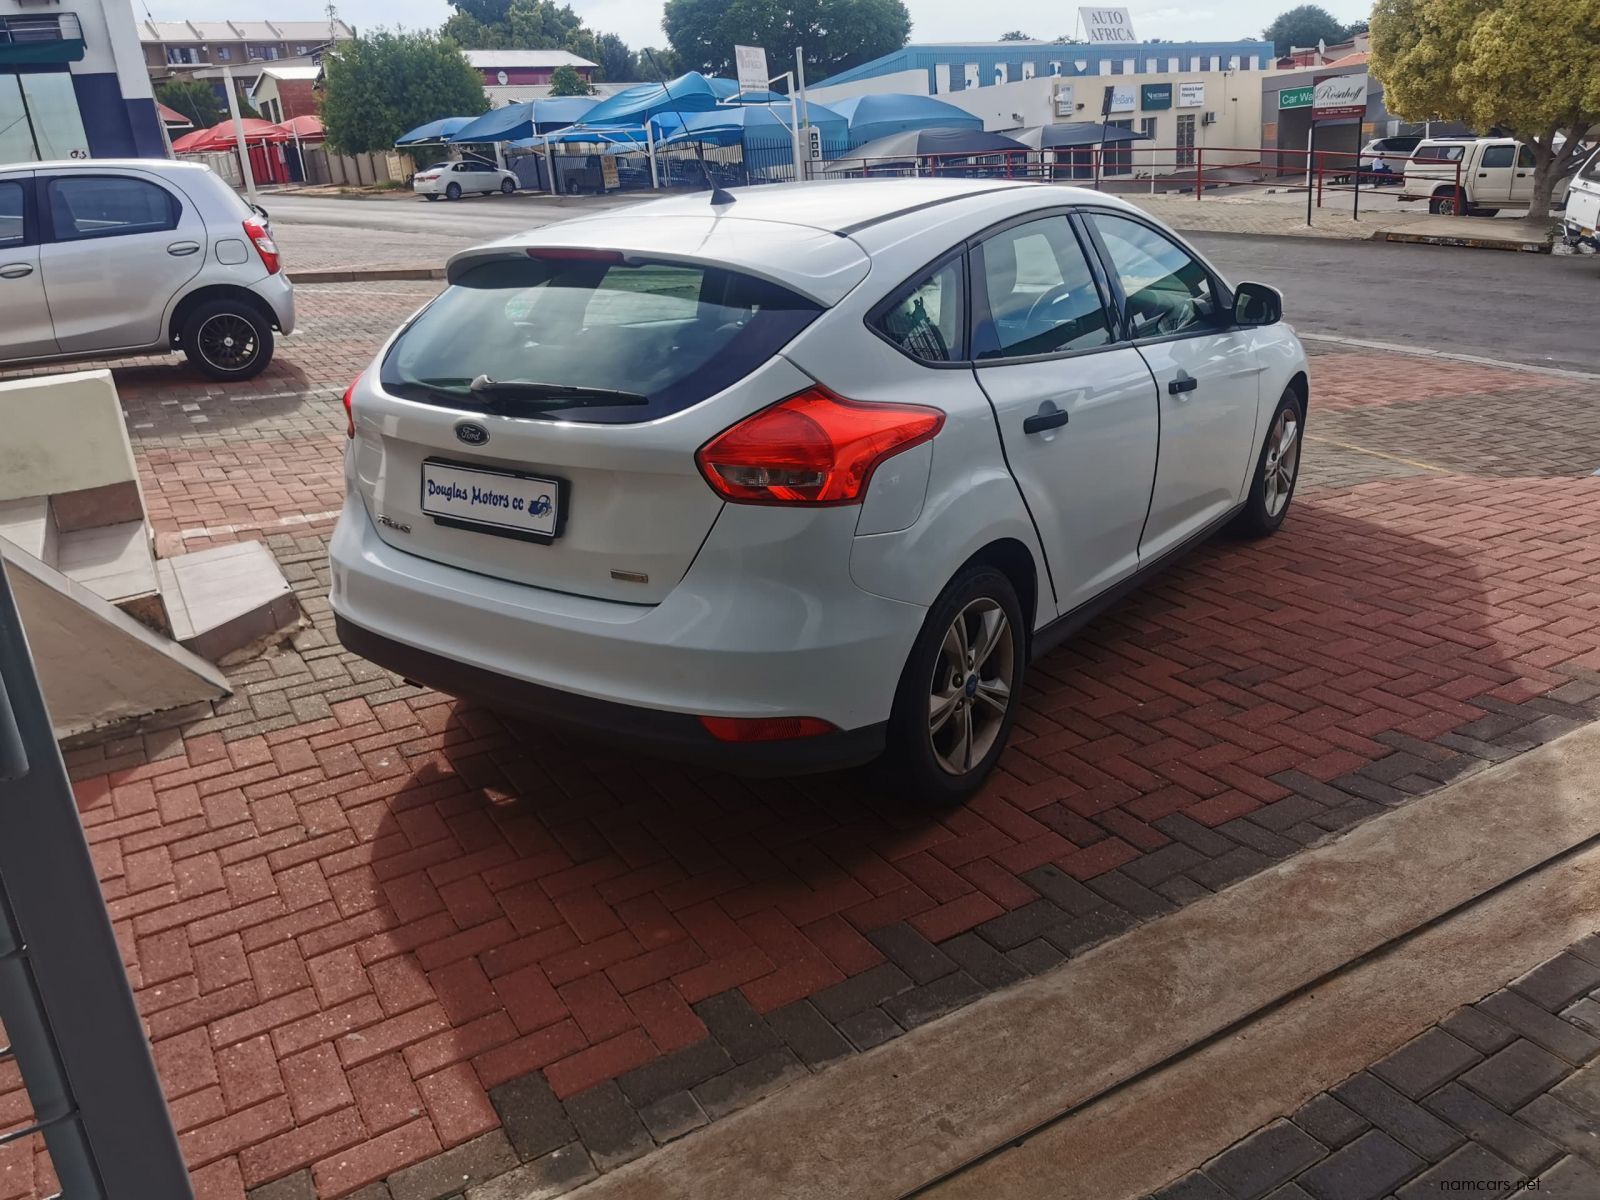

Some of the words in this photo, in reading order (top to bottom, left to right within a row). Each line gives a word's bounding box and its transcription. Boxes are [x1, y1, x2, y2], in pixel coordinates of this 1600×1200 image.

[1091, 11, 1123, 24] AUTO
[1091, 27, 1135, 41] AFRICA
[1282, 94, 1298, 105] Car
[462, 426, 480, 441] Ford
[427, 479, 468, 502] Douglas
[471, 486, 509, 508] Motors
[512, 497, 523, 510] cc
